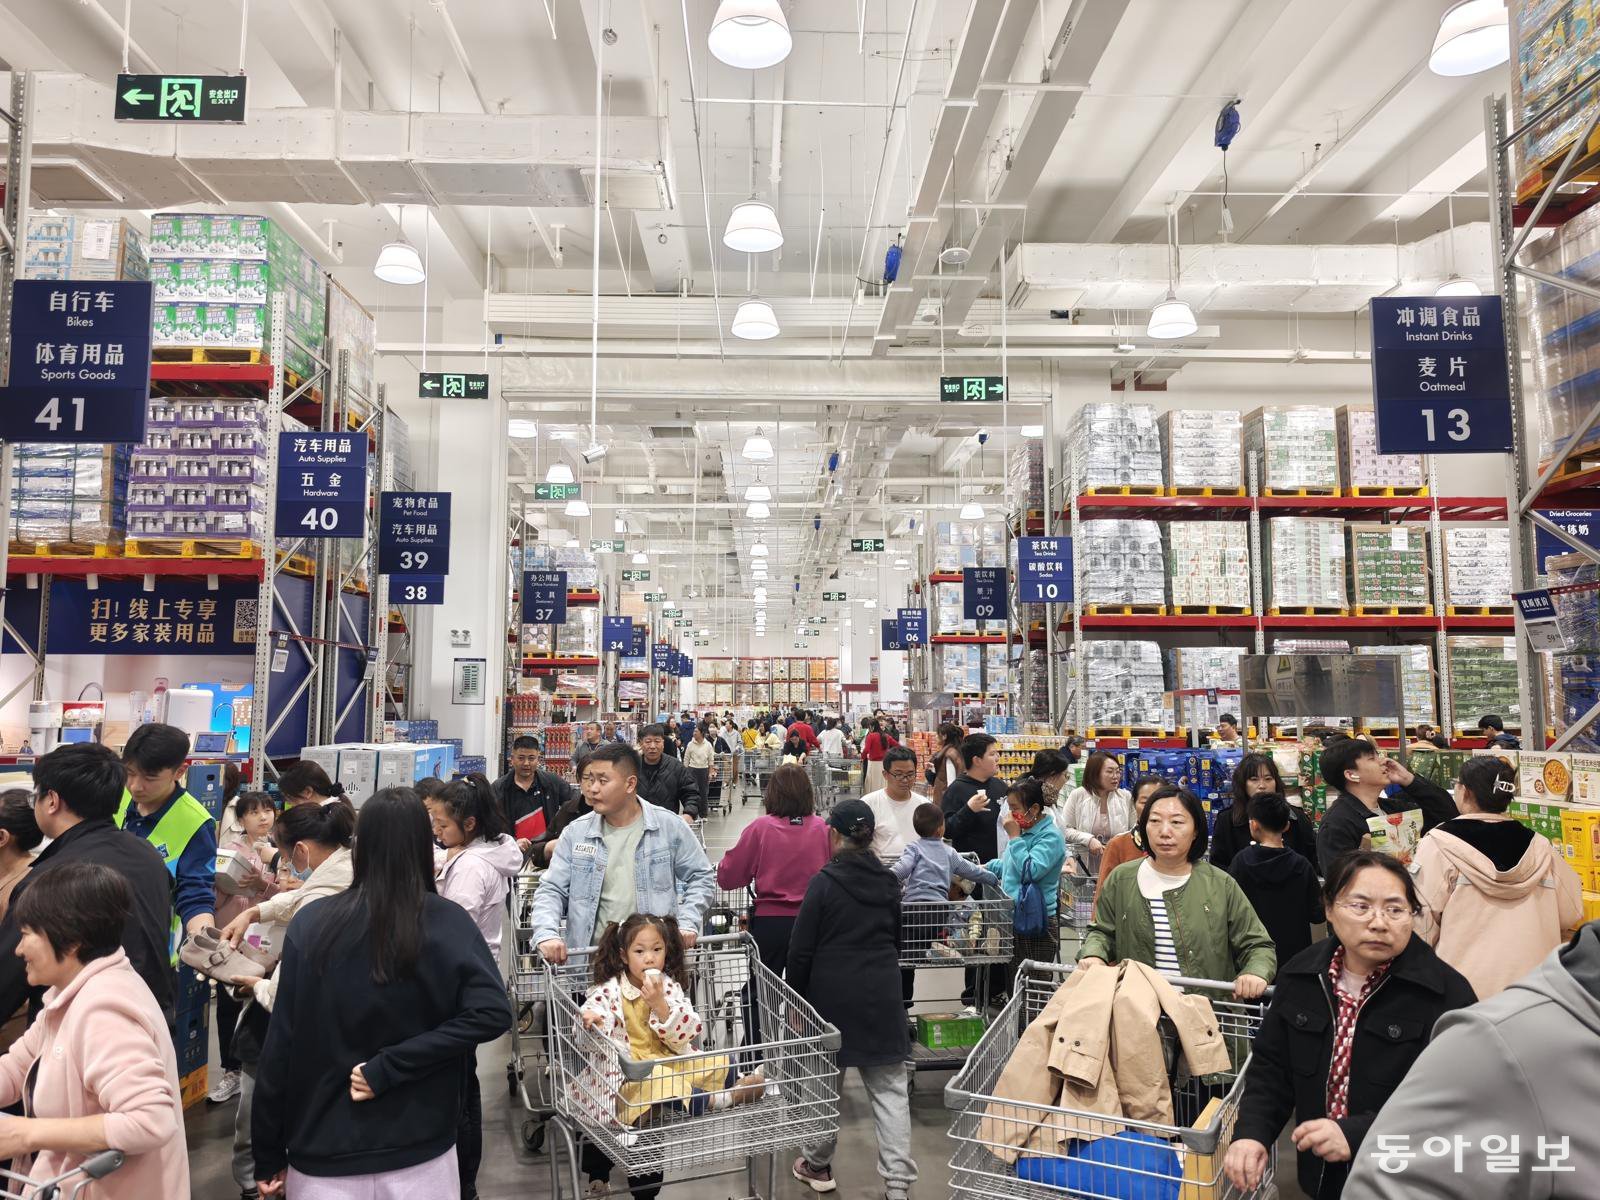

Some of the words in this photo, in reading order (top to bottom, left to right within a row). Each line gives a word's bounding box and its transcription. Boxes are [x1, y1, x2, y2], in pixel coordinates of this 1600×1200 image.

[209, 89, 239, 99] 安全出口
[50, 291, 115, 313] 自行车
[67, 316, 94, 328] Bikes
[1396, 306, 1481, 328] 冲调食品
[1406, 331, 1439, 341] Instant
[1442, 331, 1473, 341] Drinks
[36, 342, 124, 365] 体育用品
[1418, 356, 1468, 377] 麦片
[41, 369, 76, 382] Sports
[79, 369, 116, 380] Goods
[1420, 381, 1466, 391] Oatmeal
[35, 397, 85, 431] 41
[1421, 408, 1471, 442] 13
[294, 438, 352, 453] 汽车用品
[317, 455, 347, 464] Supplies
[301, 472, 342, 487] 五金
[303, 489, 339, 497] Hardware
[392, 497, 439, 509] 宠物食品
[301, 507, 339, 531] 40
[391, 523, 438, 536] 汽车用品
[410, 537, 434, 545] Supplies
[1031, 541, 1058, 550] 茶饮料
[399, 551, 429, 569] 39
[1028, 562, 1063, 572] 碳酸饮料
[530, 574, 560, 582] 办公用品
[974, 570, 996, 579] 茶饮料
[404, 586, 427, 600] 38
[1036, 584, 1059, 599] 10
[535, 609, 554, 621] 37
[976, 605, 994, 617] 09
[90, 623, 216, 643] 更多家装用品
[906, 633, 919, 642] 06
[610, 641, 624, 650] 34
